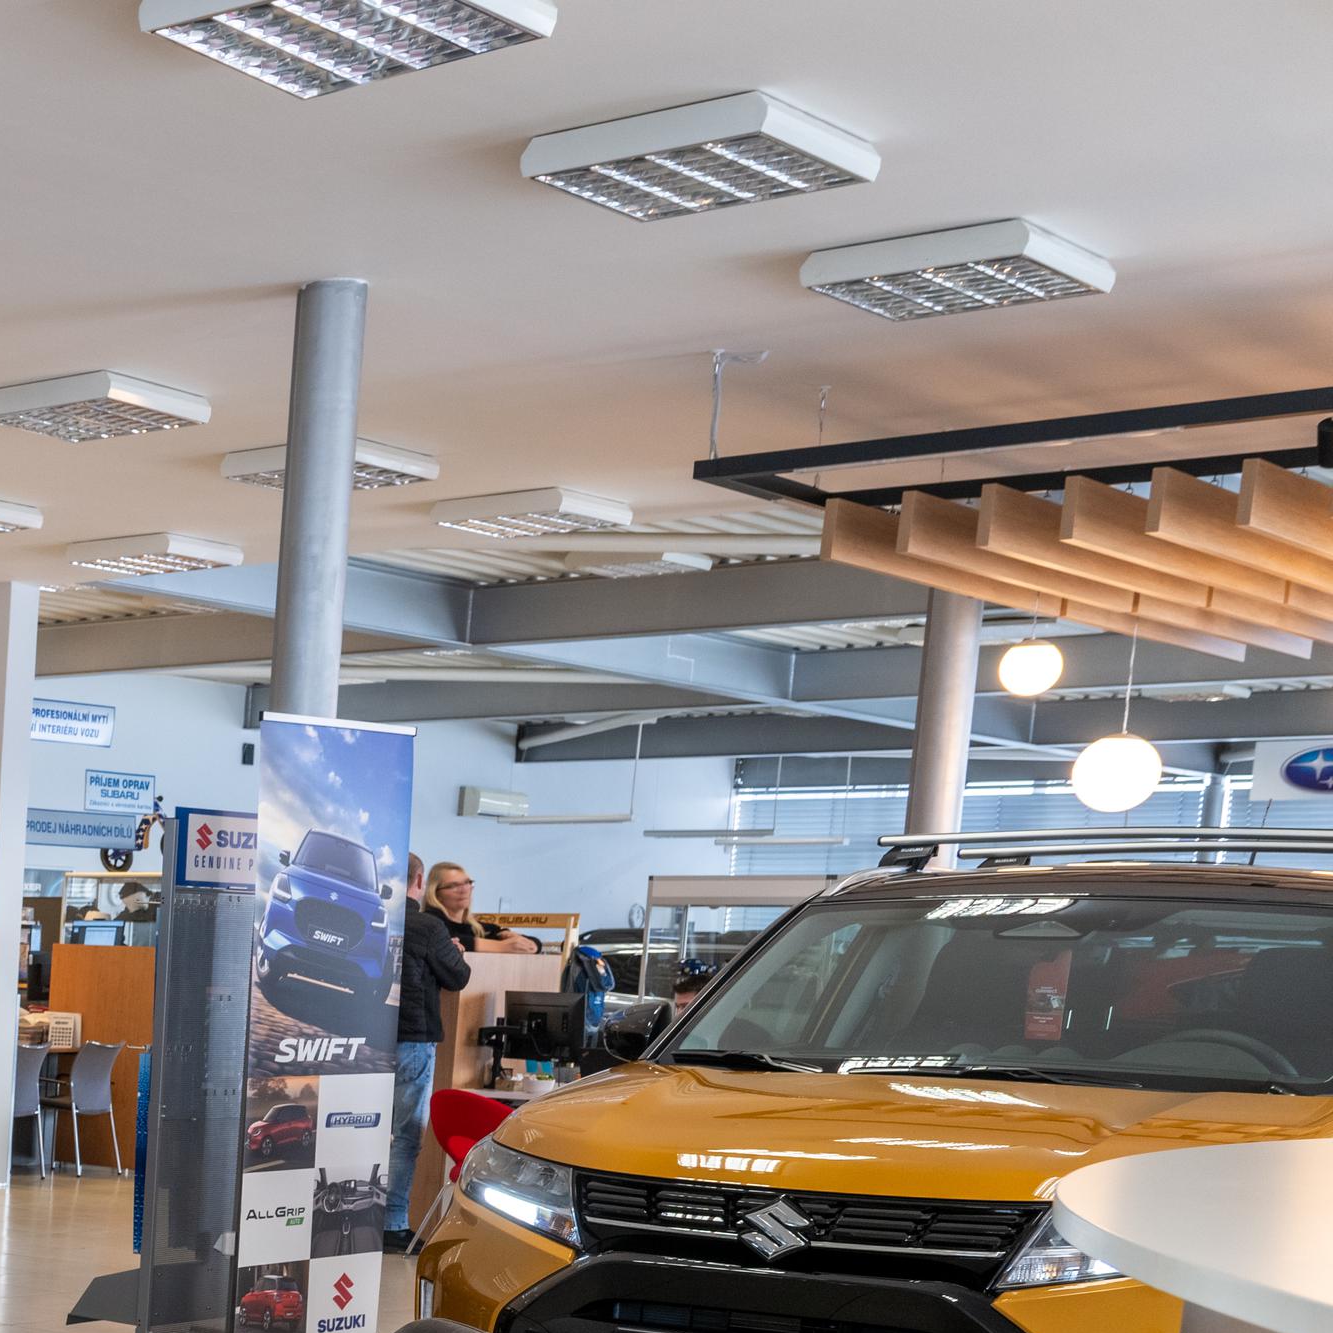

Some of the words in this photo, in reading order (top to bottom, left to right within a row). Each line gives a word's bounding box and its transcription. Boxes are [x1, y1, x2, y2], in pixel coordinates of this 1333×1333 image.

[39, 722, 79, 736] INTERIÉRU
[80, 727, 100, 739] VOZU
[89, 774, 120, 788] PŘÍJEM
[122, 779, 150, 790] OPRAV
[100, 788, 140, 800] SUBARU
[58, 821, 113, 837] NÁHRADNÍCH
[194, 855, 242, 870] GENUINE
[499, 916, 548, 925] SUBARU
[313, 930, 344, 946] SWIFT
[274, 1037, 366, 1063] SWIFT
[333, 1115, 373, 1126] HYBRID
[318, 1314, 365, 1333] SUZUKI
